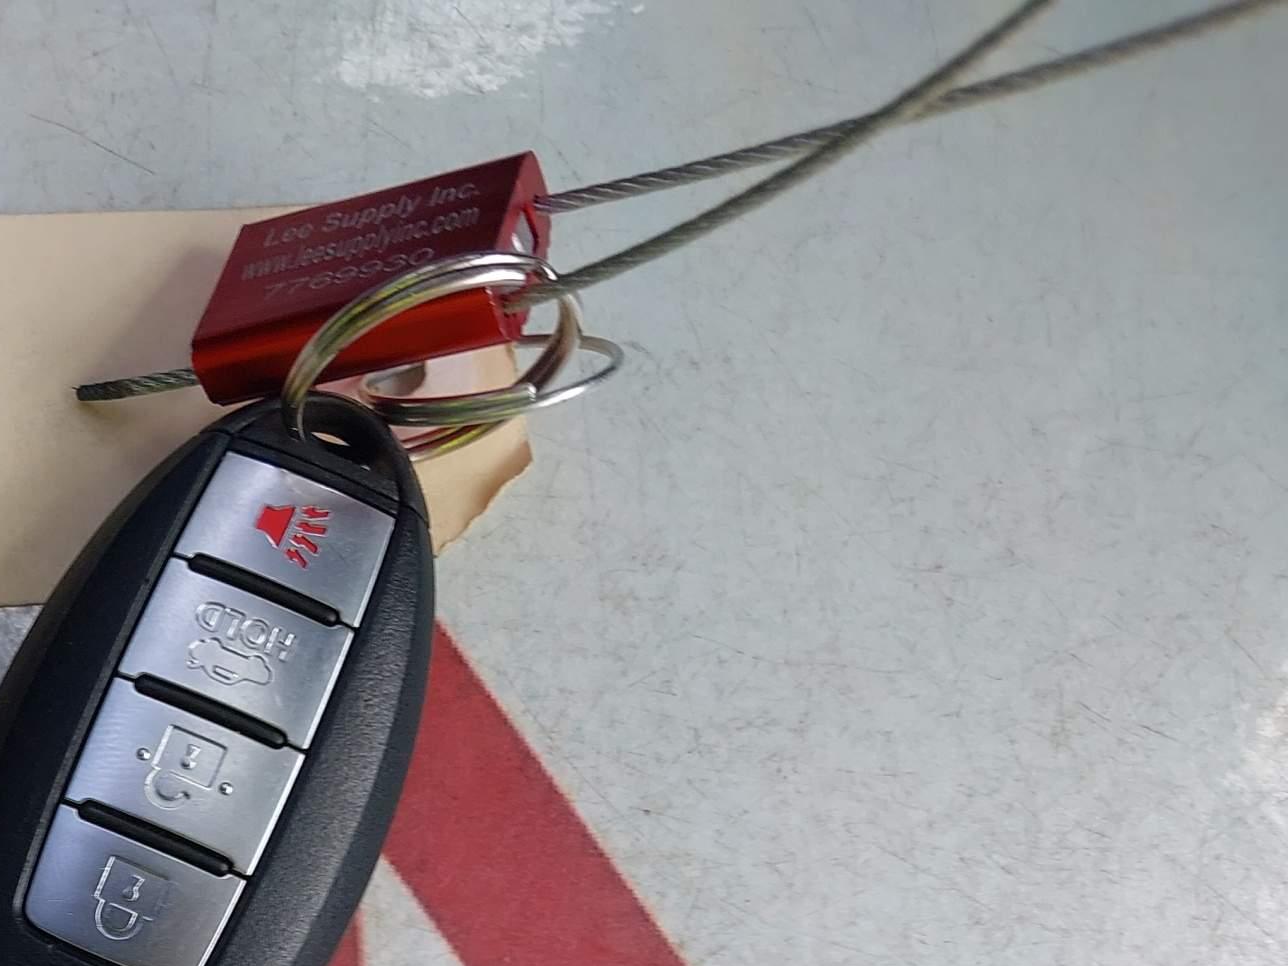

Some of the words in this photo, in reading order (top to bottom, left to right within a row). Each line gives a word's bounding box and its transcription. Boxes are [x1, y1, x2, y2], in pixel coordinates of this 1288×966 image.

[244, 206, 480, 280] www.leesupplyinc.com
[266, 223, 313, 247] Lee
[323, 194, 424, 232] Supply
[429, 181, 480, 203] Inc.
[195, 601, 297, 662] HOLD
